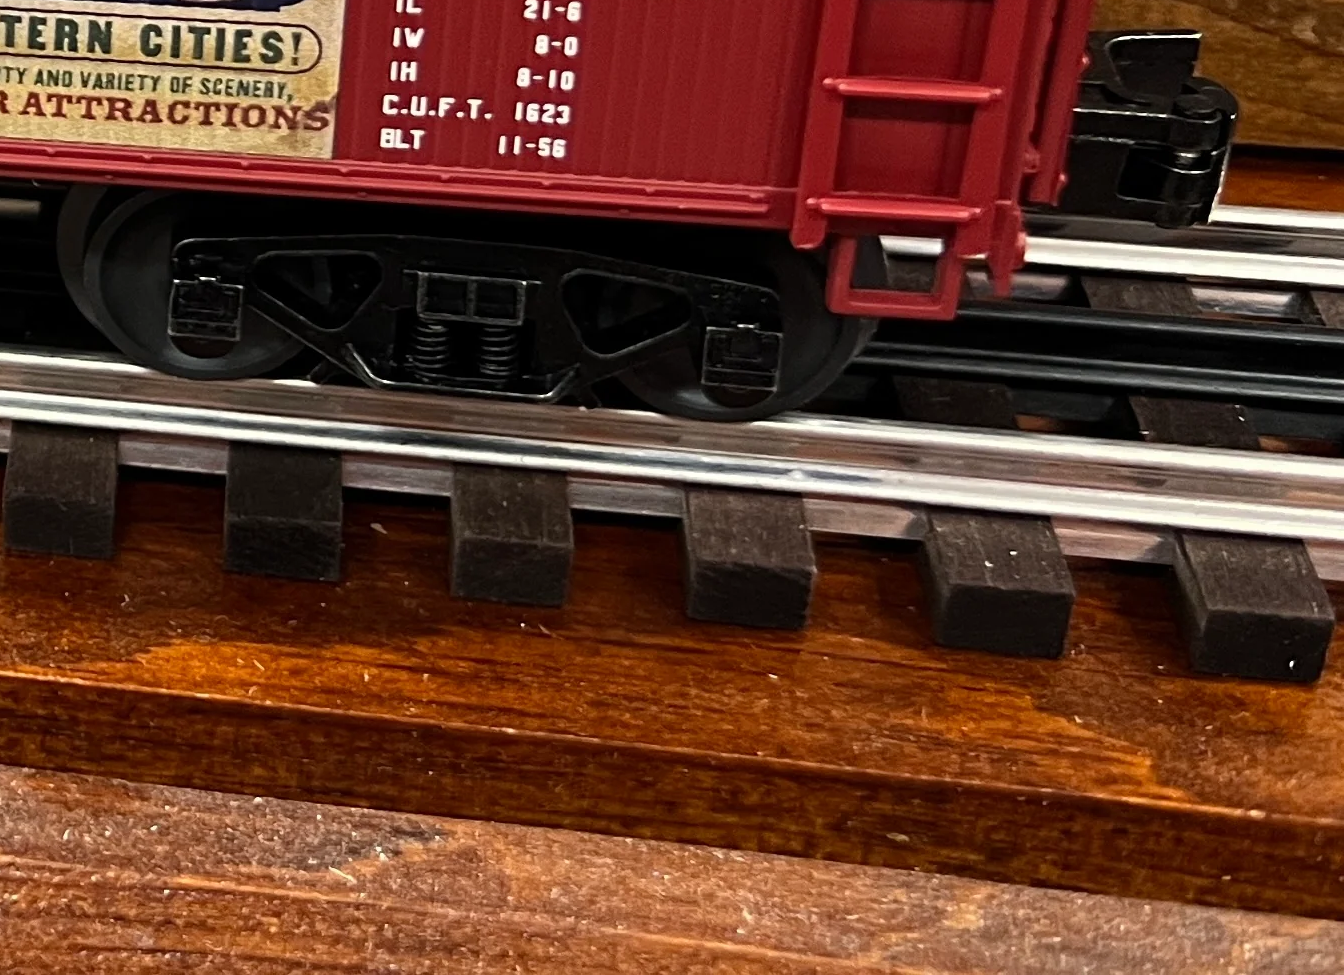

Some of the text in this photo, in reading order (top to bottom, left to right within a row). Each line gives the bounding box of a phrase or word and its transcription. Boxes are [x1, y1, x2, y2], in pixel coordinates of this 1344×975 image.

[139, 23, 302, 66] CITIES!
[392, 27, 579, 57] IW 8-0
[33, 67, 73, 88] AND
[80, 71, 163, 94] VARIETY
[170, 76, 193, 94] OF
[199, 77, 294, 104] SCENERY,
[389, 61, 576, 92] IH 8-10
[21, 91, 330, 132] ATTRACTIONS
[381, 94, 571, 125] C.U.F.T. 1623
[379, 128, 567, 159] BLT 11-56
